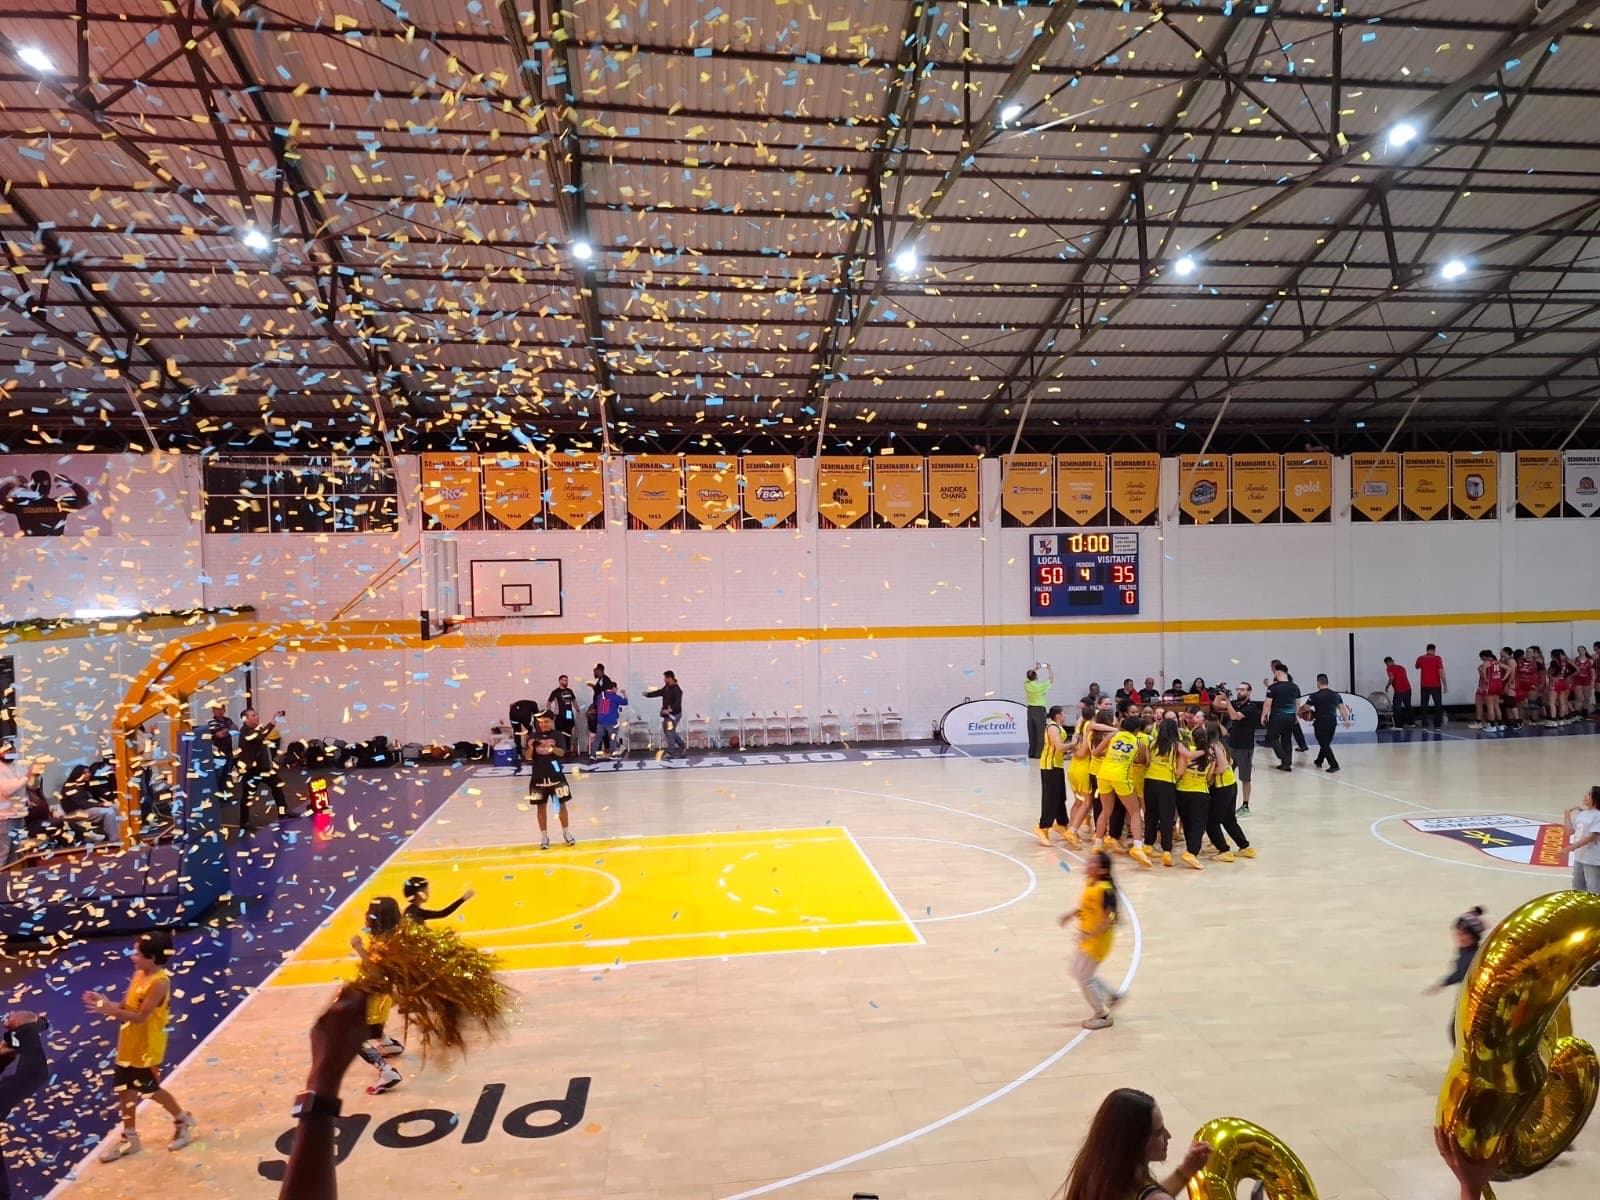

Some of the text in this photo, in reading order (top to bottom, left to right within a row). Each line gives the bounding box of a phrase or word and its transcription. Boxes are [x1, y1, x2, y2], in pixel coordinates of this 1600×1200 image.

[1072, 535, 1110, 553] 0:00
[1037, 555, 1136, 565] LOCAL VISITANTE
[1041, 565, 1135, 585] 50 4 35
[1040, 590, 1135, 606] 0 0
[968, 721, 1017, 731] Electrolit
[1112, 740, 1134, 753] 33
[315, 791, 329, 810] 24
